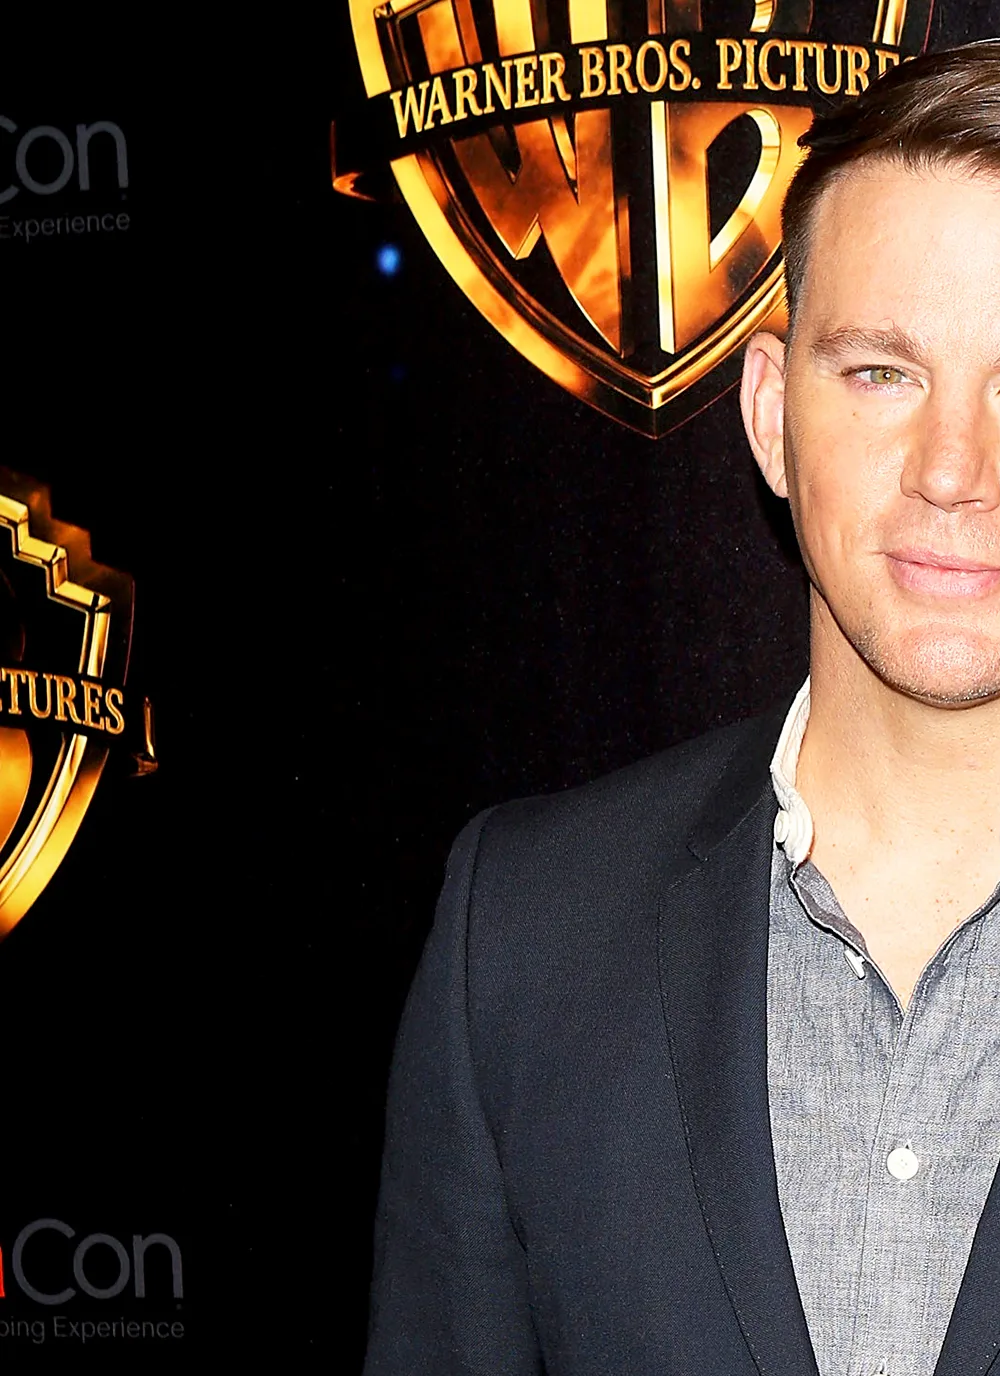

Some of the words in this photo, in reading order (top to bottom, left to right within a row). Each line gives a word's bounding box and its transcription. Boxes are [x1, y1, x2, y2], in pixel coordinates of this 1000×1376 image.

[390, 53, 572, 139] WARNER
[579, 39, 702, 99] BROS.
[715, 38, 918, 97] PICTUR
[0, 113, 130, 205] on
[0, 667, 126, 736] TURES
[0, 1217, 185, 1306] Con
[53, 1315, 186, 1345] Experience
